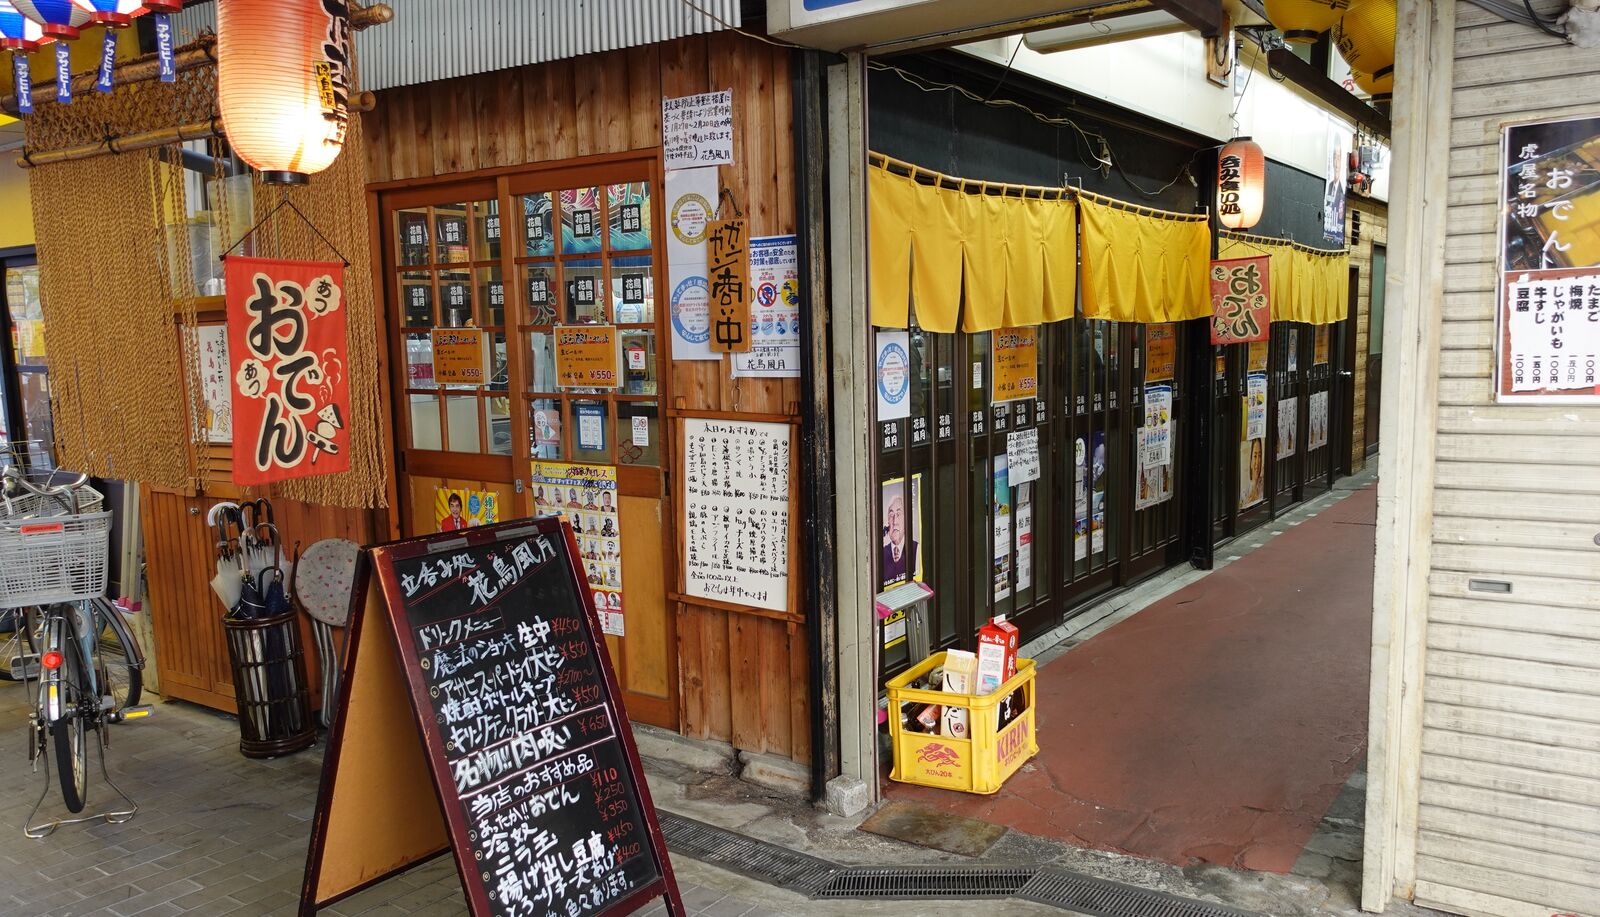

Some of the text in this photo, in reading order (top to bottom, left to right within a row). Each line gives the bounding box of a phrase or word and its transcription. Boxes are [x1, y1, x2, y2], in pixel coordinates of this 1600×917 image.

[158, 25, 173, 76] アサヒビール
[100, 39, 115, 87] アサヒビール
[56, 51, 70, 97] アサヒビール
[17, 63, 31, 107] アサヒビール
[701, 150, 730, 161] 花鳥風月
[1517, 143, 1539, 218] 虎屋名物
[623, 208, 638, 219] 花鳥
[1542, 167, 1575, 252] おでん
[527, 216, 541, 227] 花鳥
[575, 213, 590, 224] 花鳥
[624, 218, 639, 230] 風月
[446, 222, 458, 232] 花鳥
[528, 227, 542, 238] 風月
[575, 224, 591, 235] 風月
[446, 232, 459, 242] 風月
[450, 285, 463, 296] 花鳥
[532, 281, 546, 291] 花鳥
[578, 280, 593, 290] 花鳥
[626, 279, 641, 290] 花鳥
[316, 279, 332, 313] あつ
[412, 287, 424, 297] 花鳥
[532, 291, 547, 301] 風月
[578, 290, 593, 301] 風月
[626, 290, 641, 301] 風月
[413, 297, 425, 307] 風月
[451, 295, 463, 305] 風月
[1516, 287, 1529, 312] 豆腐
[1532, 287, 1547, 383] 牛すじ 一五〇円
[1550, 286, 1565, 383] じゃがいも 一〇〇円
[1567, 285, 1583, 383] 梅焼 一五〇円
[1586, 285, 1600, 383] たまご 一〇〇円
[747, 359, 786, 370] 花鳥風月
[248, 276, 320, 468] おでん
[244, 363, 261, 396] あつ
[913, 417, 925, 429] 花鳥
[939, 414, 950, 425] 花鳥
[973, 411, 983, 422] 花鳥
[884, 422, 897, 435] 花鳥
[939, 426, 950, 438] 風月
[973, 421, 983, 434] 風月
[884, 435, 897, 448] 風月
[913, 429, 926, 442] 風月
[401, 553, 476, 597] 立呑み処
[467, 534, 557, 605] 花鳥風月
[419, 617, 502, 650] ドリンクメニュー
[517, 615, 551, 648] 生中
[442, 674, 556, 722] 焼酎ボトルキープ
[997, 719, 1029, 764] KIRIN
[472, 753, 594, 820] 当店のおすすめ品
[482, 822, 538, 860] 冷奴
[495, 829, 559, 876] ニラ玉
[497, 830, 605, 905] 揚げ出し豆腐
